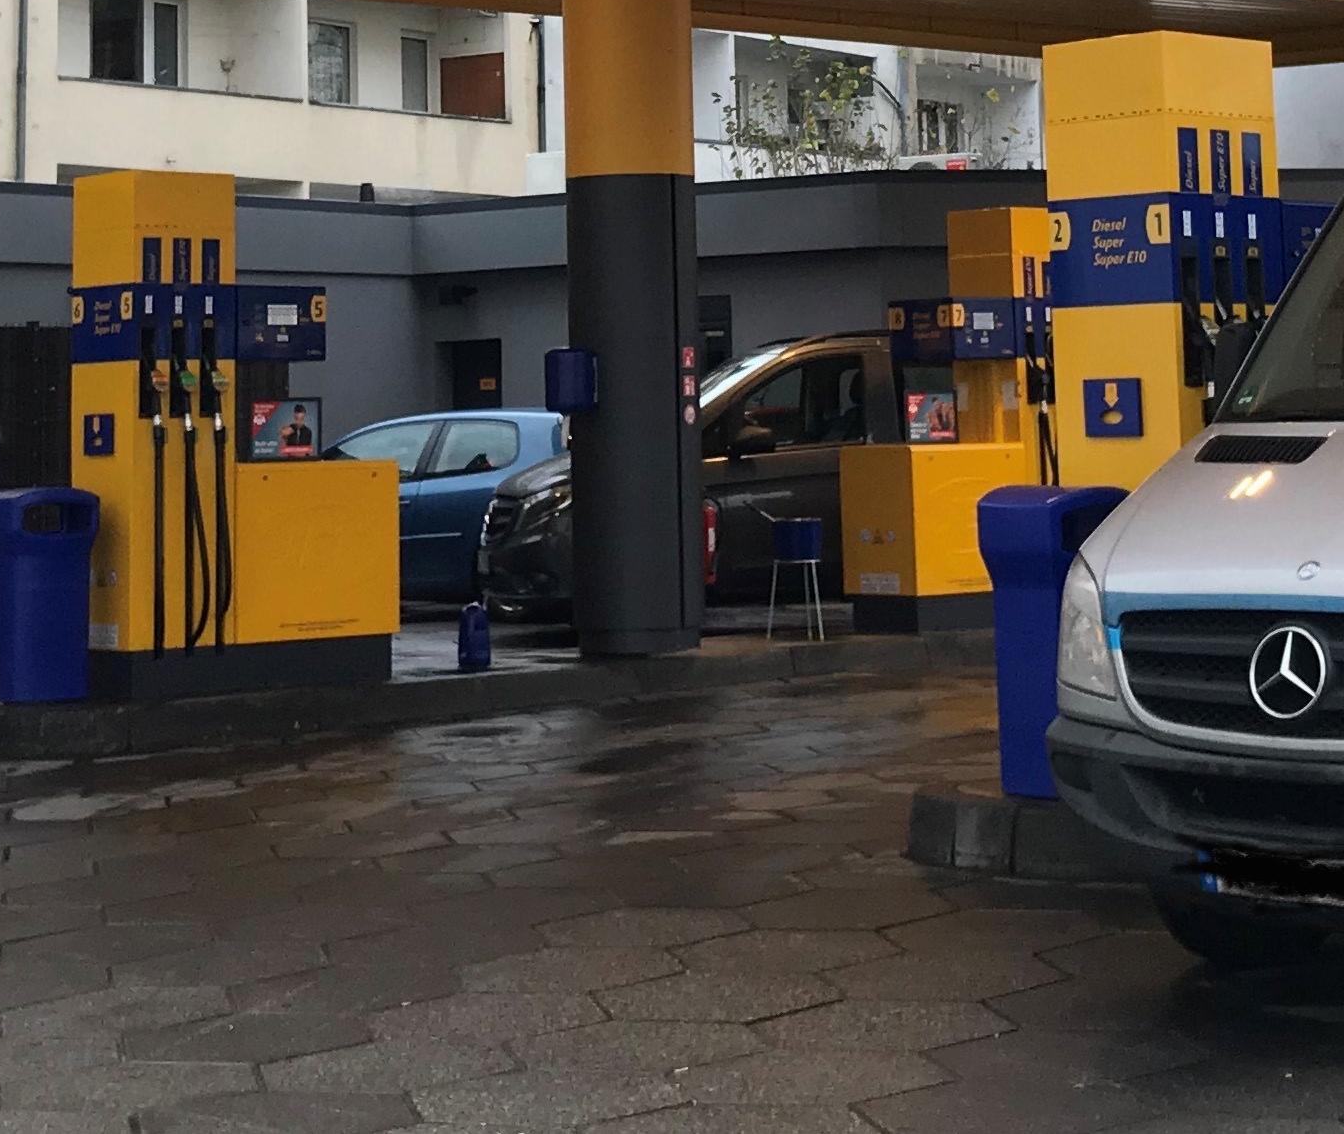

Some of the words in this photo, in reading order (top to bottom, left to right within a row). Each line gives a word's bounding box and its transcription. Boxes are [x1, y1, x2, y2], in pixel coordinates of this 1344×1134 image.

[1184, 151, 1195, 190] Diesel
[1053, 219, 1063, 243] 2
[1091, 217, 1127, 233] Diesel
[1154, 212, 1163, 237] 1
[1092, 236, 1126, 252] Super
[1093, 253, 1125, 270] Super
[1126, 250, 1147, 264] E10
[74, 303, 81, 320] 6
[123, 296, 130, 316] 5
[315, 301, 324, 319] 5
